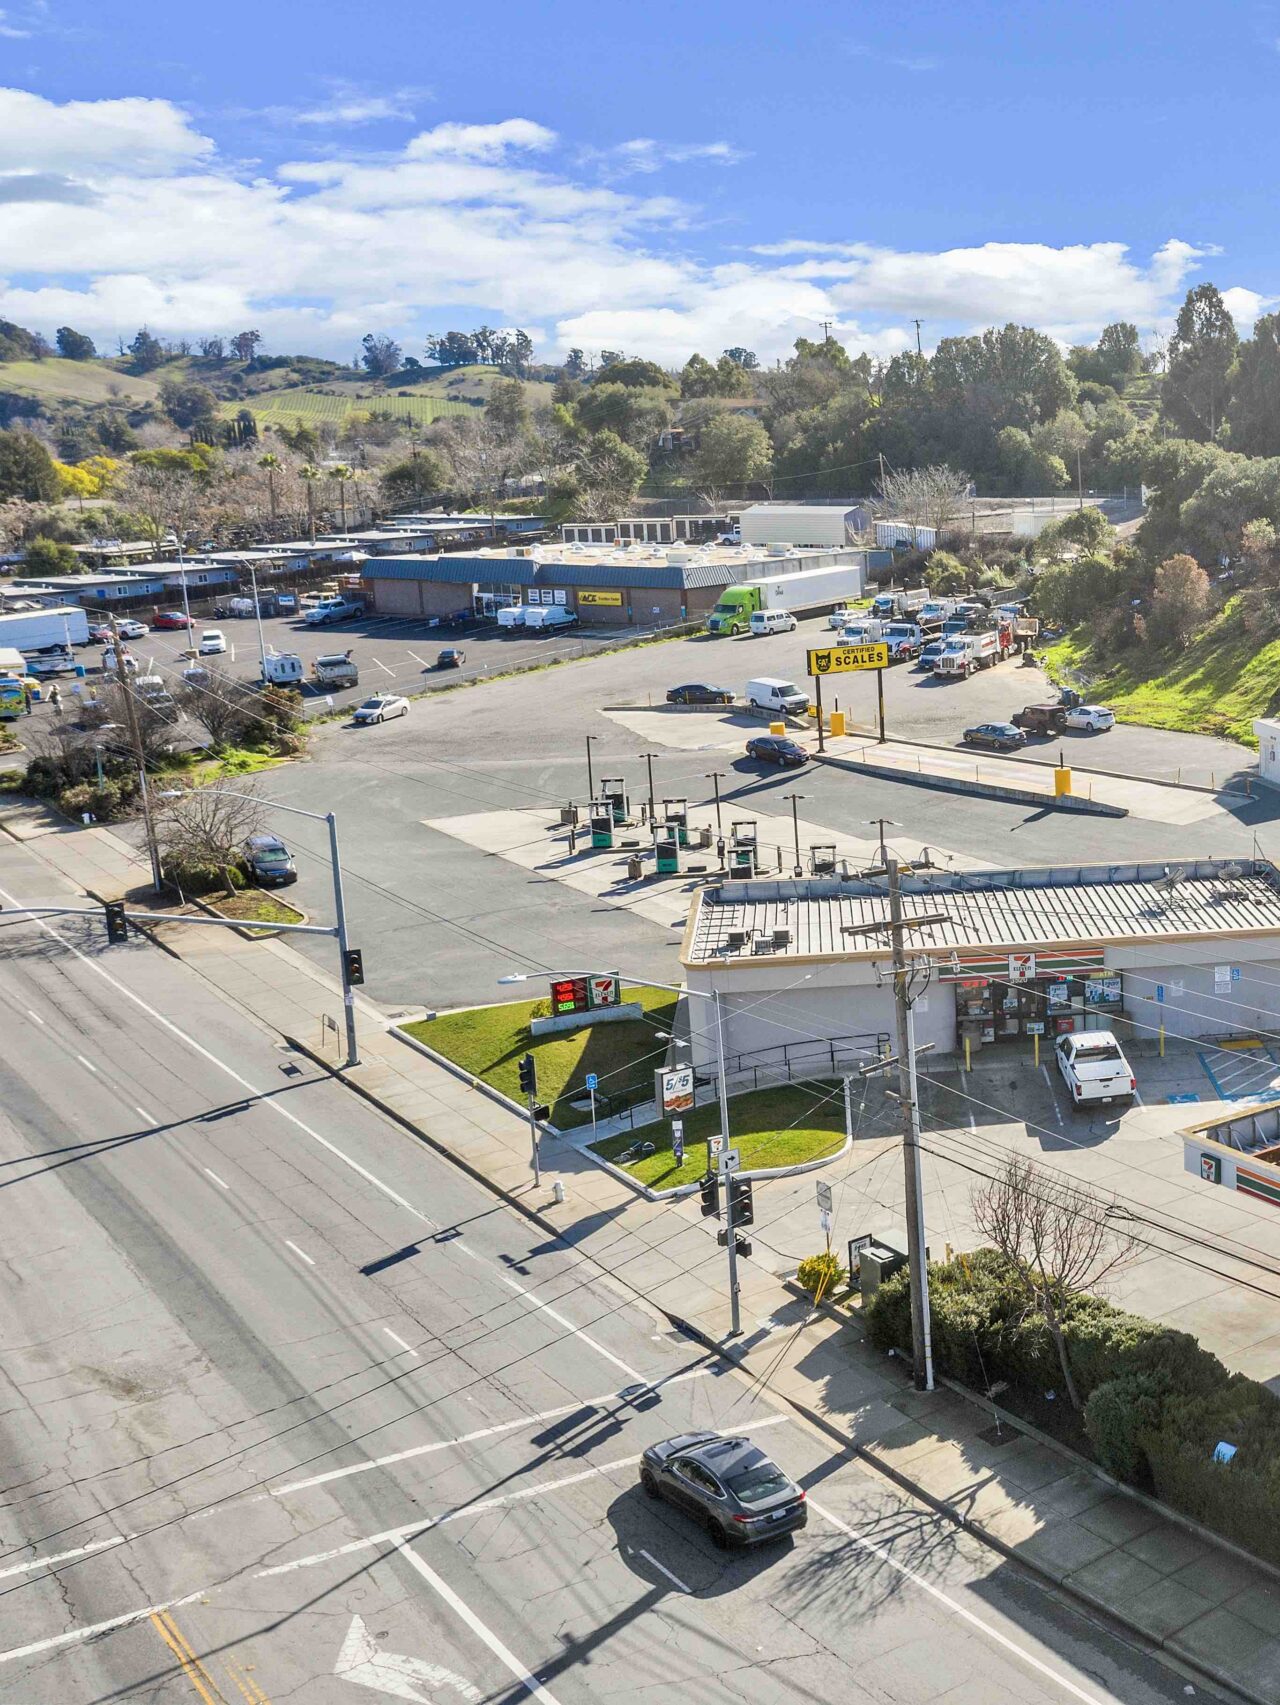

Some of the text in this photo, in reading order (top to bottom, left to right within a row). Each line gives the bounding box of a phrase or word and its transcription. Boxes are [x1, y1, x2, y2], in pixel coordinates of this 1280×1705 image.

[582, 593, 597, 602] ACE
[843, 647, 875, 655] CERTIFIED
[818, 659, 829, 667] CAT
[835, 652, 883, 666] SCALES
[1013, 955, 1031, 977] 7
[595, 990, 613, 998] ELEVEN
